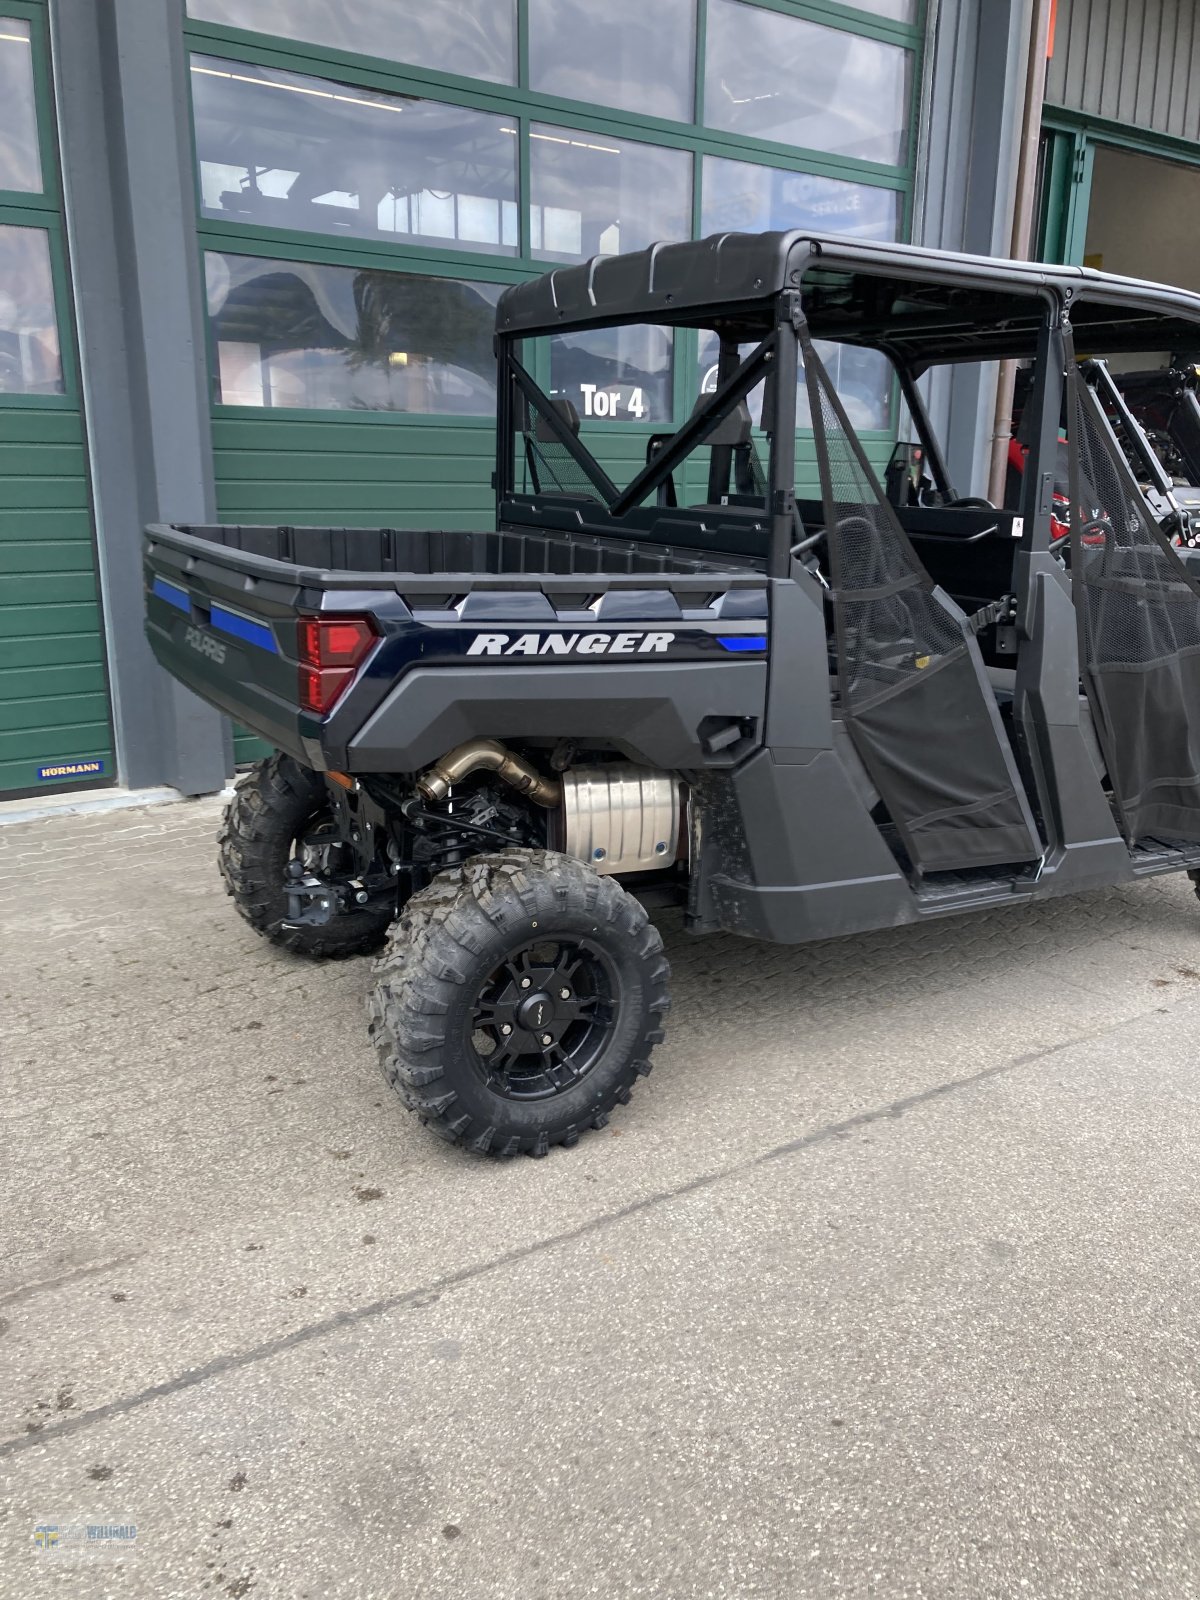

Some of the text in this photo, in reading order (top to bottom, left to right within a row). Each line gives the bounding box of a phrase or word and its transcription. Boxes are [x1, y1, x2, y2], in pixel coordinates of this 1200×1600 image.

[580, 384, 644, 418] Tor 4
[185, 626, 227, 665] POLARIS
[466, 632, 676, 655] RANGER
